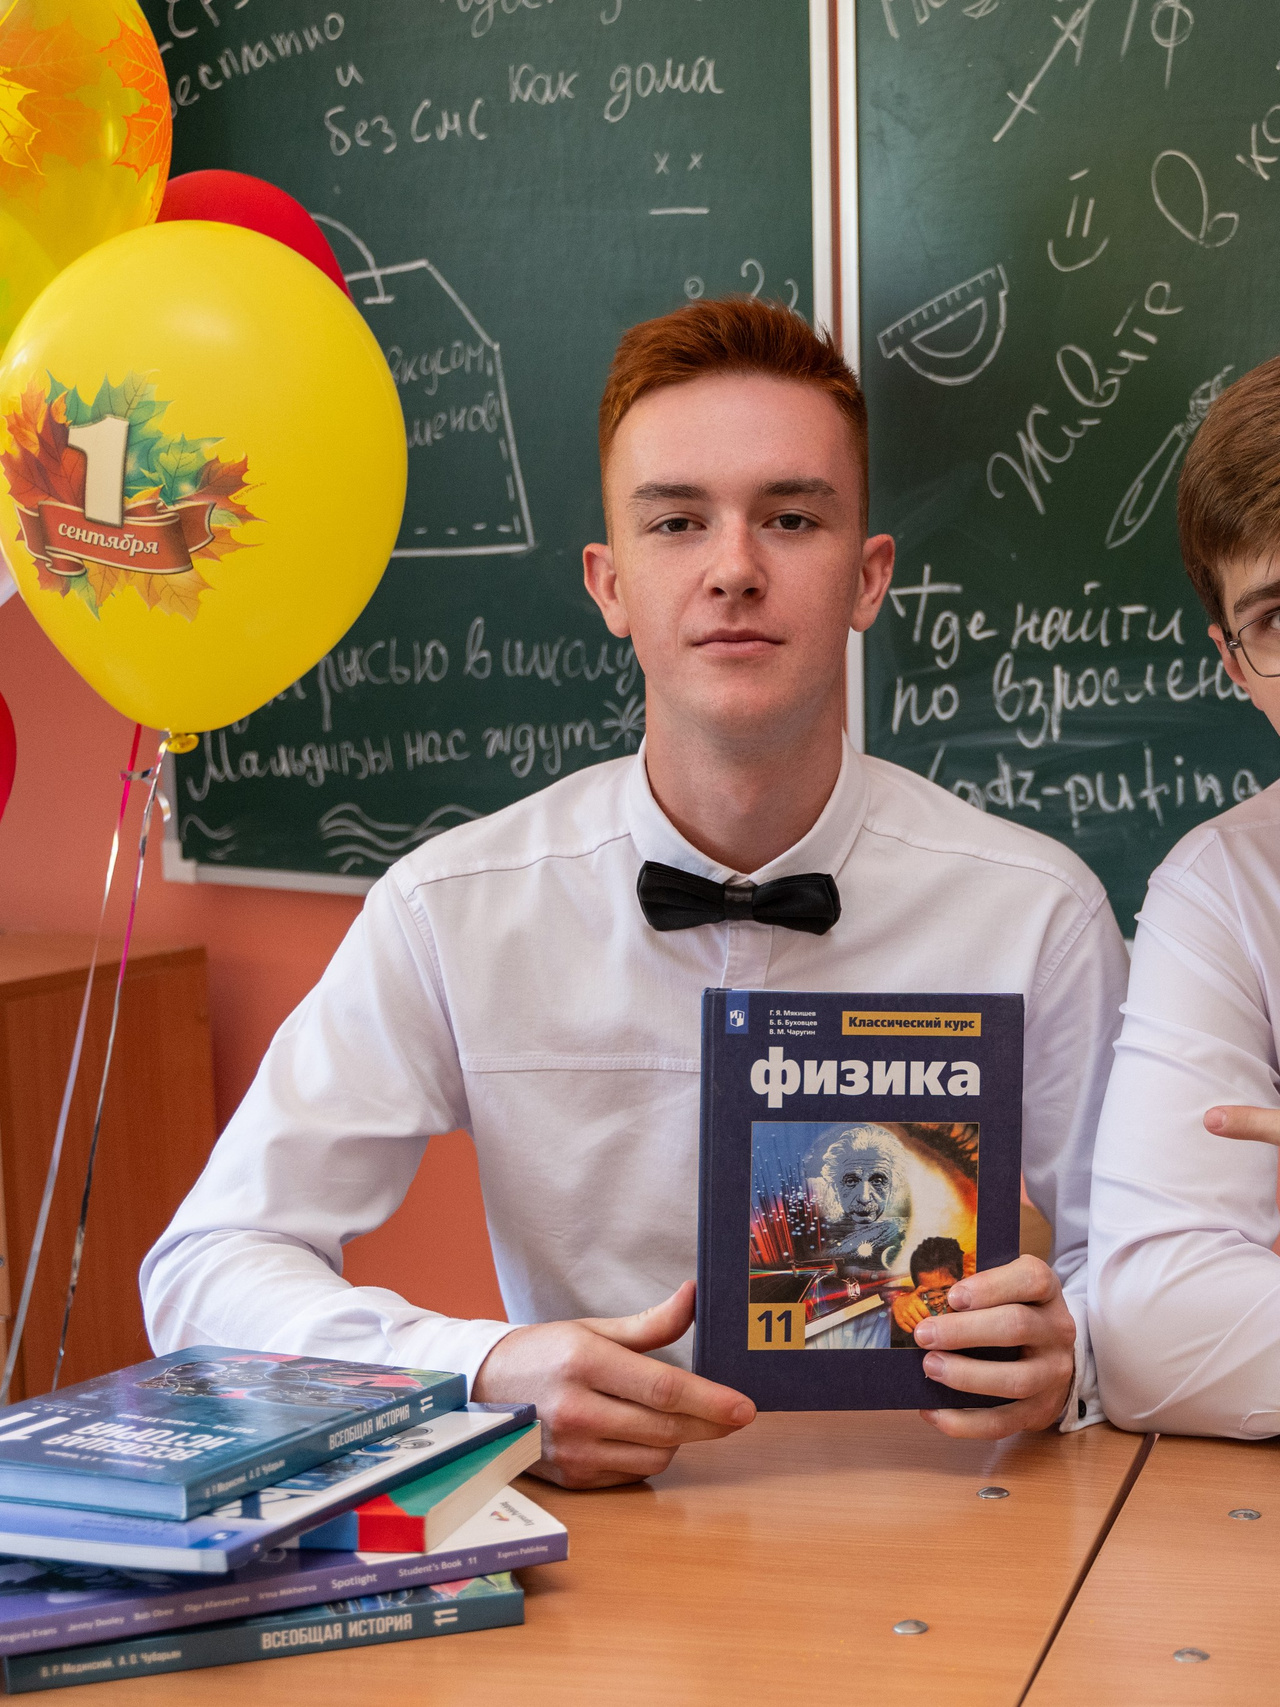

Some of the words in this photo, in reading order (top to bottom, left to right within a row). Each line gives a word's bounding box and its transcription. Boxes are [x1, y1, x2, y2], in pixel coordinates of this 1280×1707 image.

[334, 61, 364, 88] и
[604, 54, 724, 122] дома
[323, 104, 398, 157] без
[406, 390, 499, 448] менов
[68, 414, 130, 529] 1
[57, 521, 159, 557] сентября
[1010, 582, 1186, 652] найти
[464, 616, 492, 680] в
[892, 676, 960, 735] по
[186, 730, 395, 802] Мальдивы
[404, 726, 471, 771] нас
[482, 716, 613, 779] ждут
[783, 1009, 816, 1017] Мякишев
[785, 1019, 818, 1027] Буховцев
[786, 1028, 816, 1037] Чаругин
[848, 1016, 942, 1029] Классический
[944, 1018, 976, 1032] курс
[750, 1046, 981, 1108] физика
[756, 1309, 793, 1343] 11
[73, 1421, 238, 1450] ИСТОРИЯ
[328, 1418, 374, 1451] ВСЕОБЩАЯ
[375, 1403, 411, 1432] ИСТОРИЯ
[42, 1433, 205, 1462] ВСЕОБЩАЯ
[331, 1573, 378, 1590] Spotlight
[398, 1562, 440, 1578] Student's
[441, 1558, 463, 1570] Book
[468, 1556, 478, 1565] 11
[261, 1619, 344, 1651] ВСЕОБЩАЯ
[347, 1612, 414, 1639] ИСТОРИЯ
